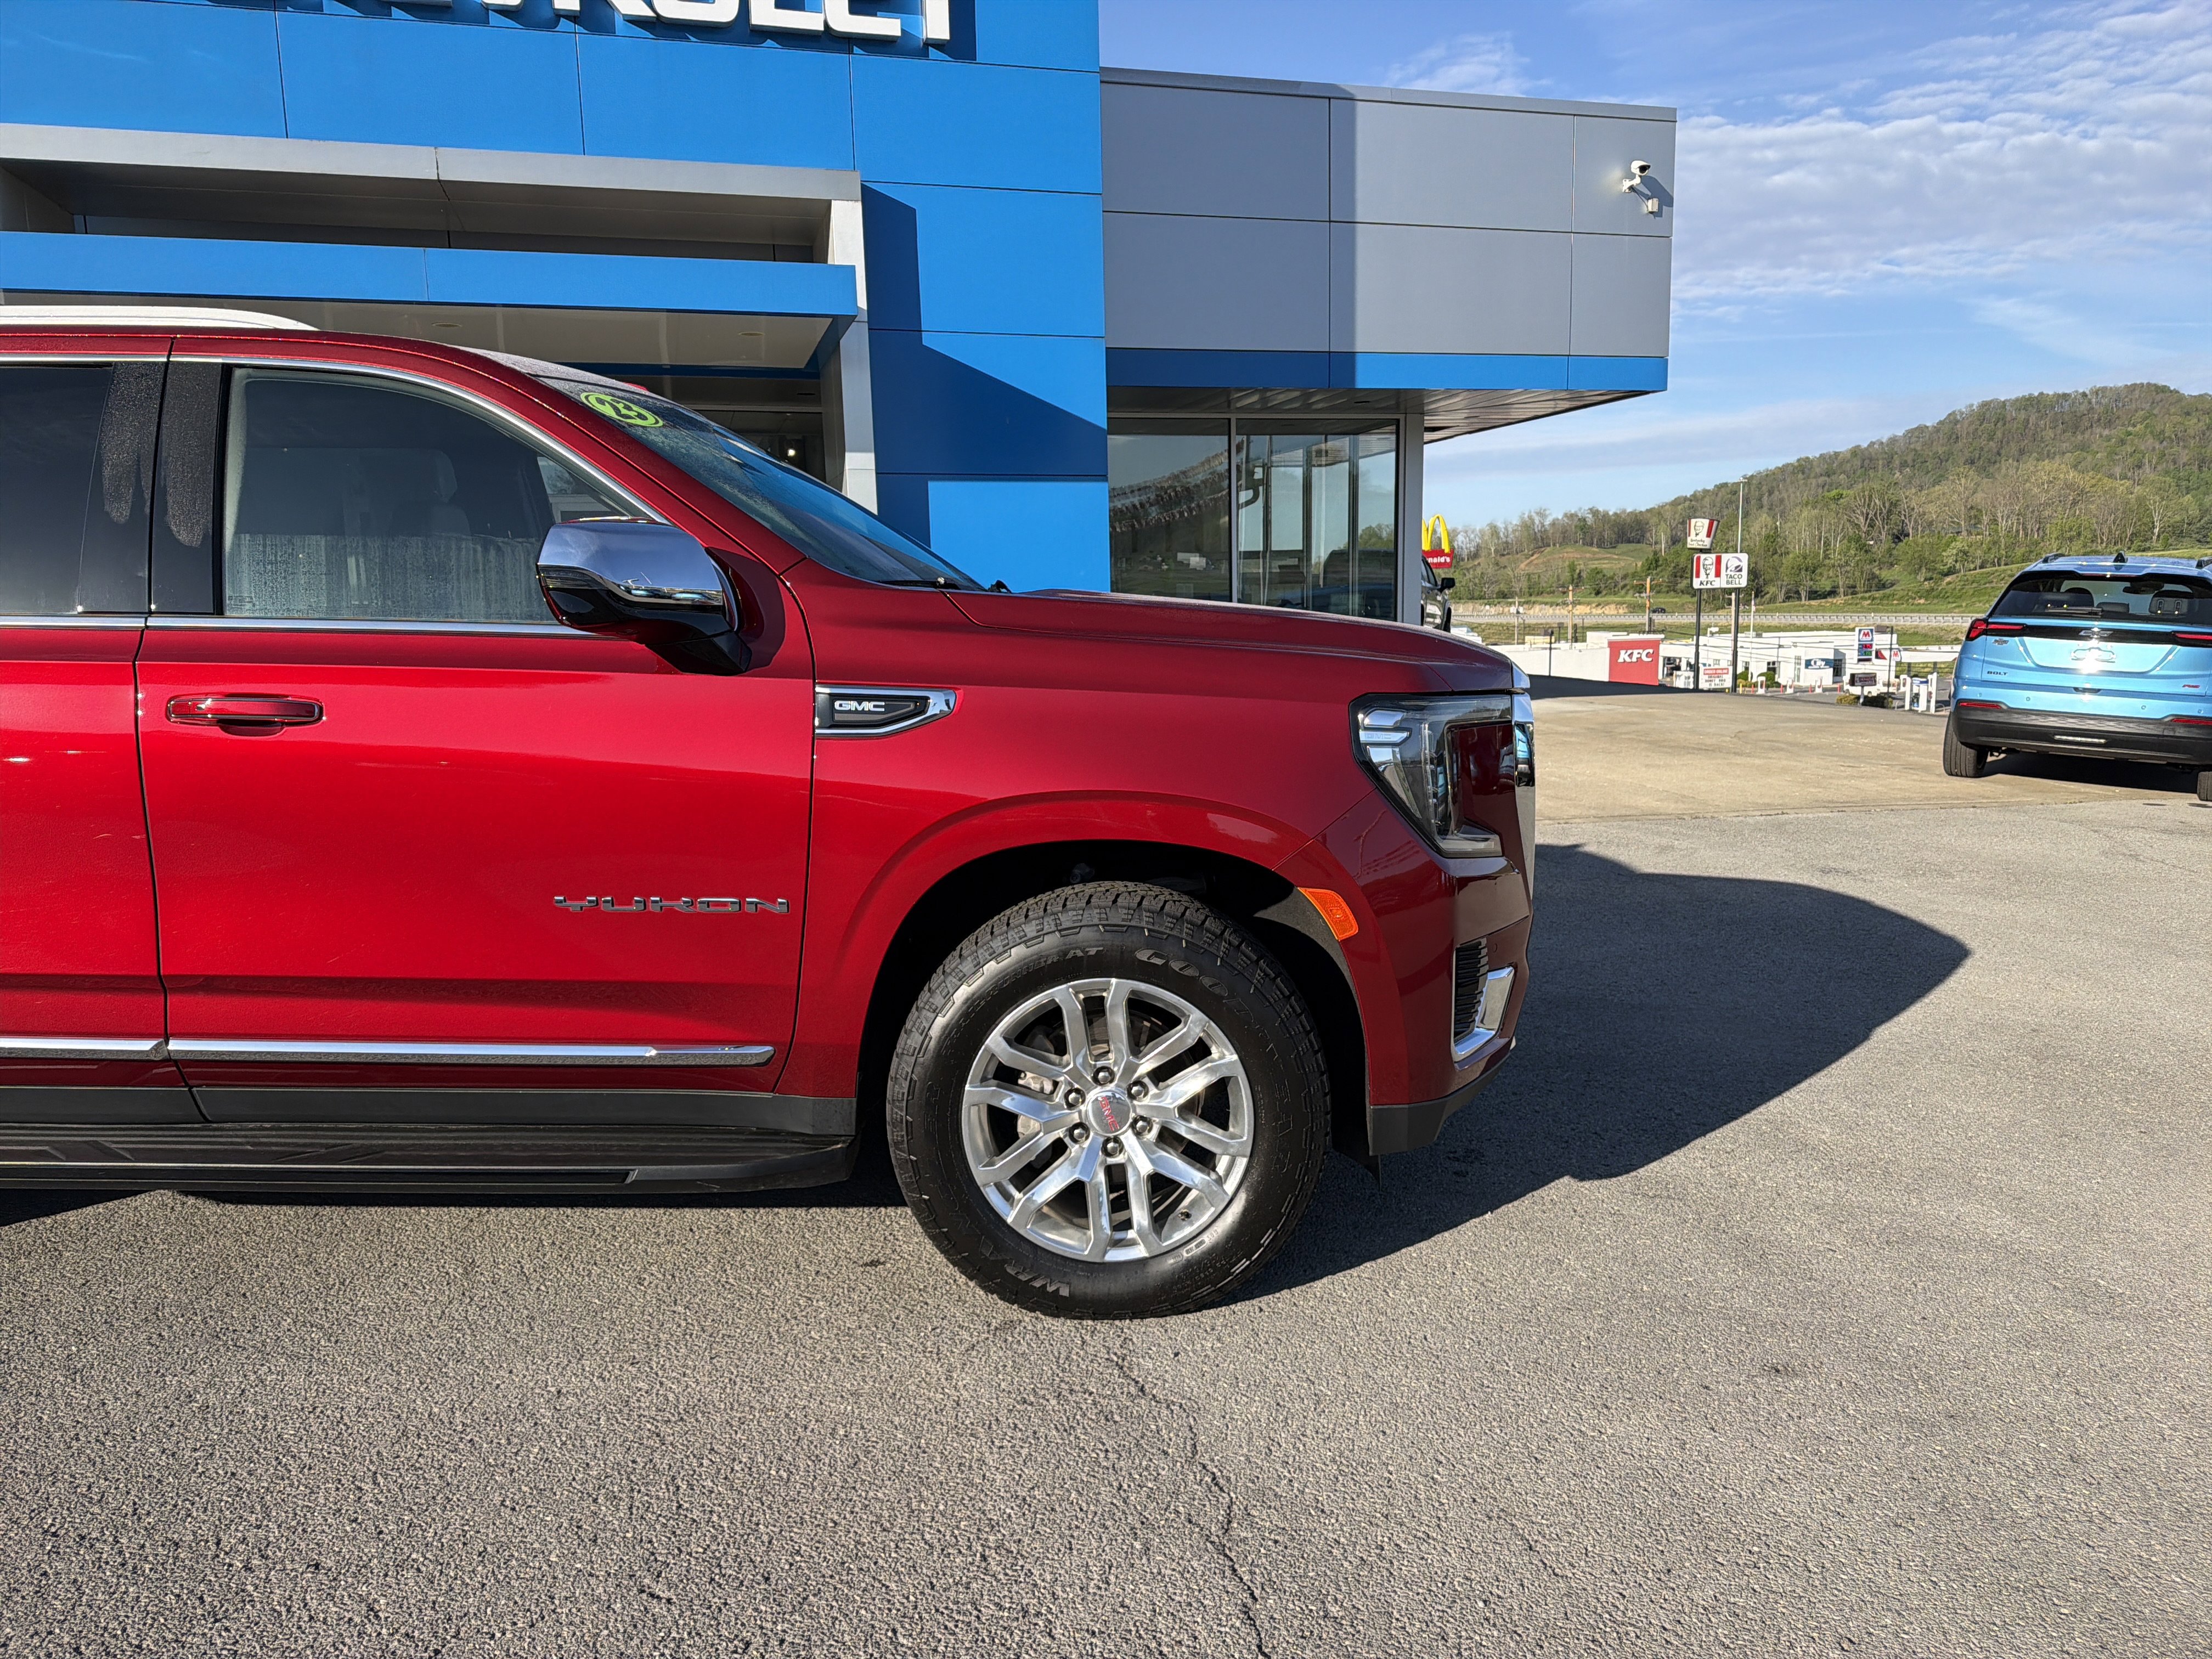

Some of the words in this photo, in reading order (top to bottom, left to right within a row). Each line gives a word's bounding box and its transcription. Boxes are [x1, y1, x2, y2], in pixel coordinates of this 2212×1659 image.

[595, 397, 648, 421] 23
[1617, 649, 1655, 663] KFC
[1811, 659, 1826, 667] City
[834, 700, 885, 712] GMC
[554, 895, 790, 913] YUKON
[1098, 1096, 1119, 1132] GMC
